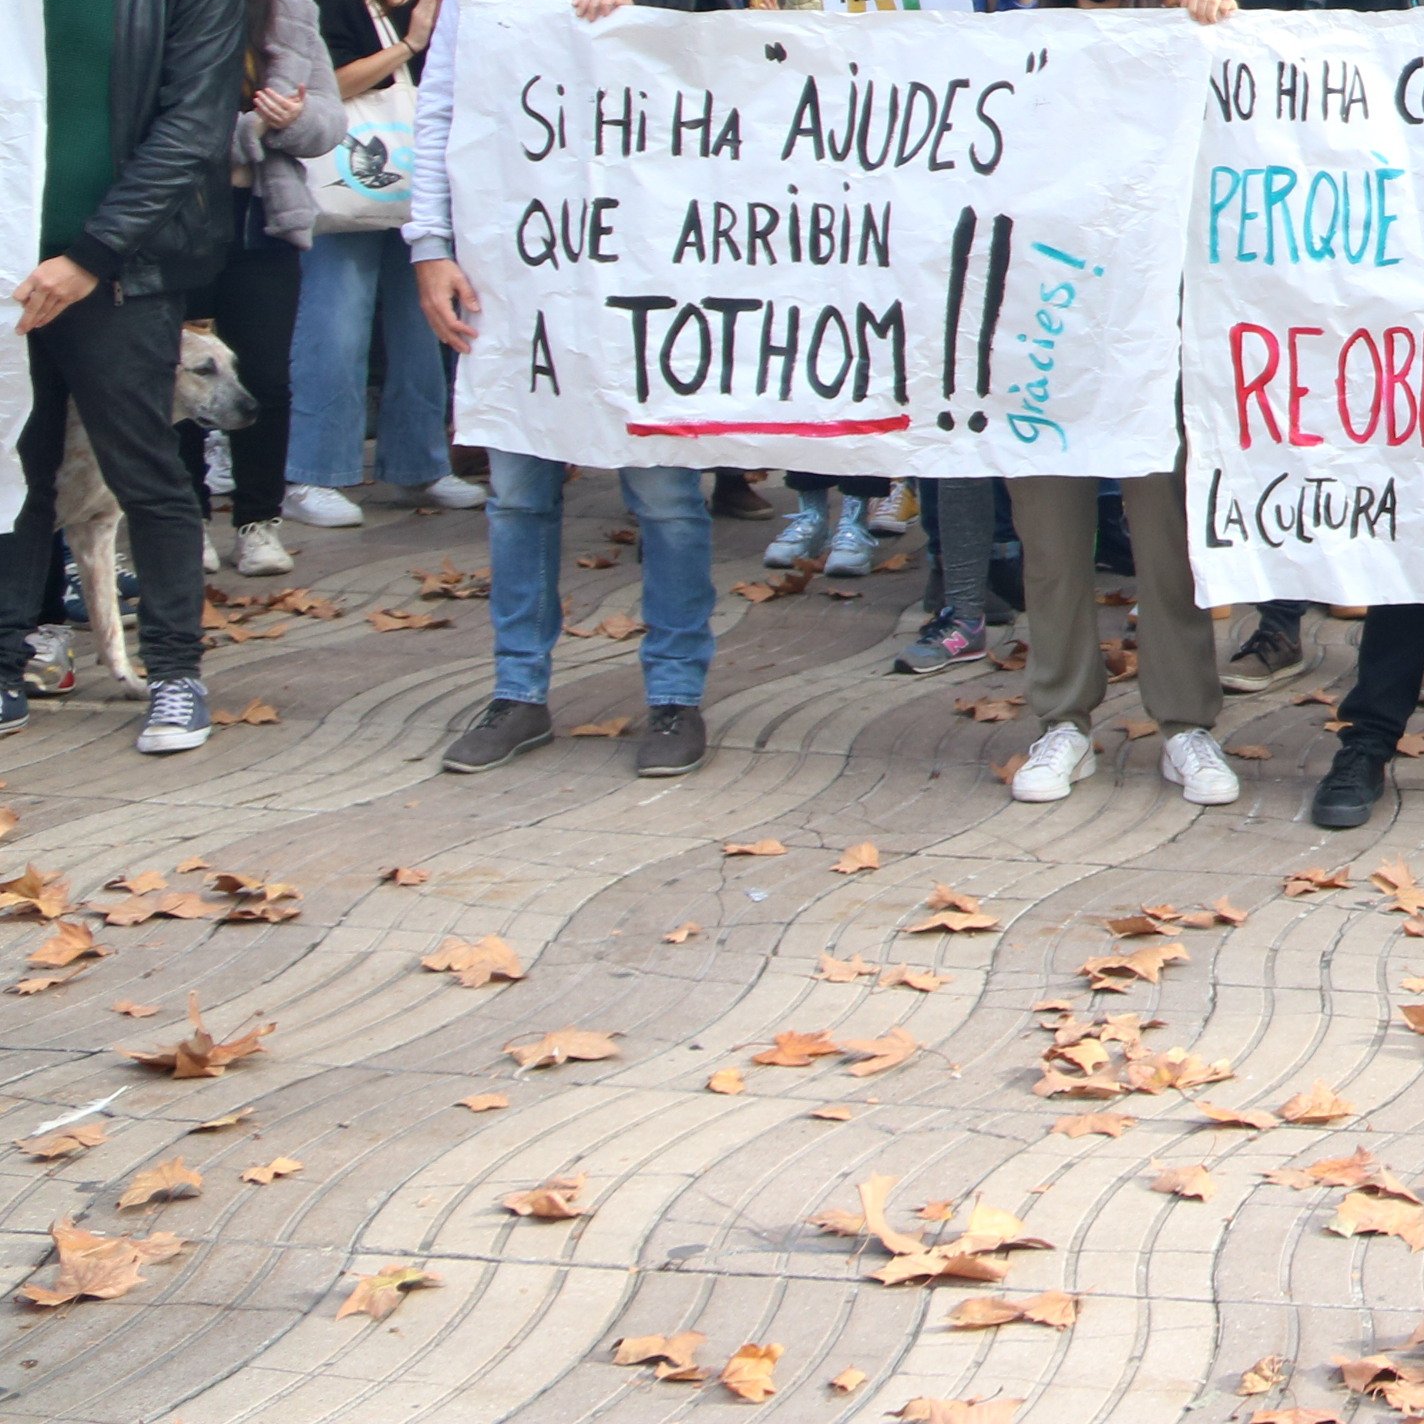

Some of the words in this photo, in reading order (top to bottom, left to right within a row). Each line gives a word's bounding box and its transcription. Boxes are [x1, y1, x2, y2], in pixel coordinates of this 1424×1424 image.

[672, 90, 741, 160] HA
[1204, 58, 1255, 123] NO
[1323, 61, 1369, 123] HA
[515, 197, 619, 269] QUE
[531, 310, 559, 396] A
[1205, 468, 1247, 548] LA
